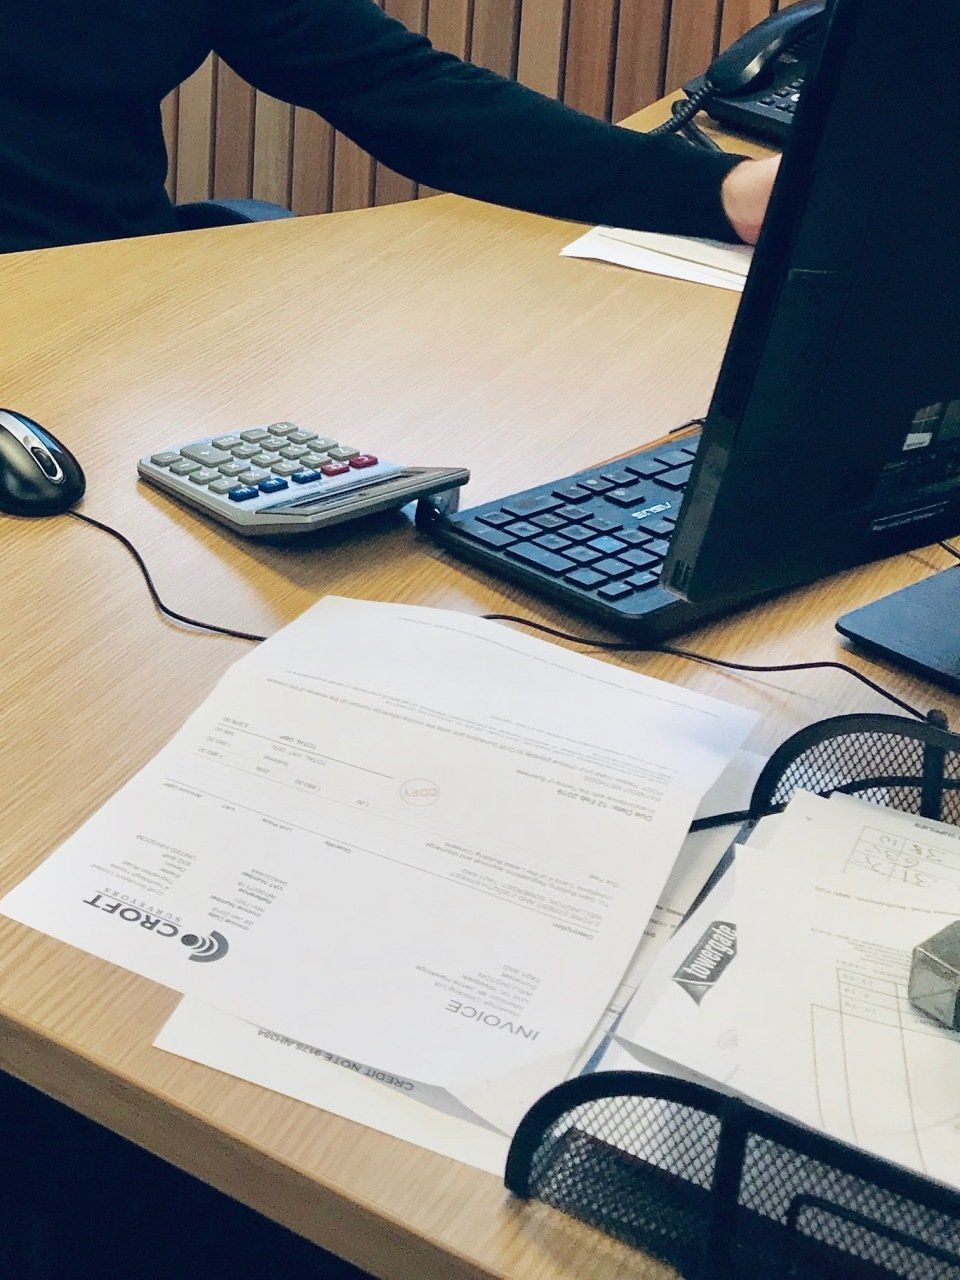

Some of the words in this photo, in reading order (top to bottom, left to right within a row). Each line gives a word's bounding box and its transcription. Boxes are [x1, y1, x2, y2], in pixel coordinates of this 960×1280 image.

[630, 500, 672, 520] ASUS
[556, 788, 578, 799] 2019
[579, 795, 596, 804] Feb
[633, 811, 653, 822] Due
[102, 886, 182, 922] SURVEYORS
[82, 891, 180, 939] CROFT
[683, 925, 736, 981] towergate
[444, 999, 539, 1040] INVOICE
[322, 1052, 361, 1071] NOTE
[363, 1068, 415, 1091] CREDIT
